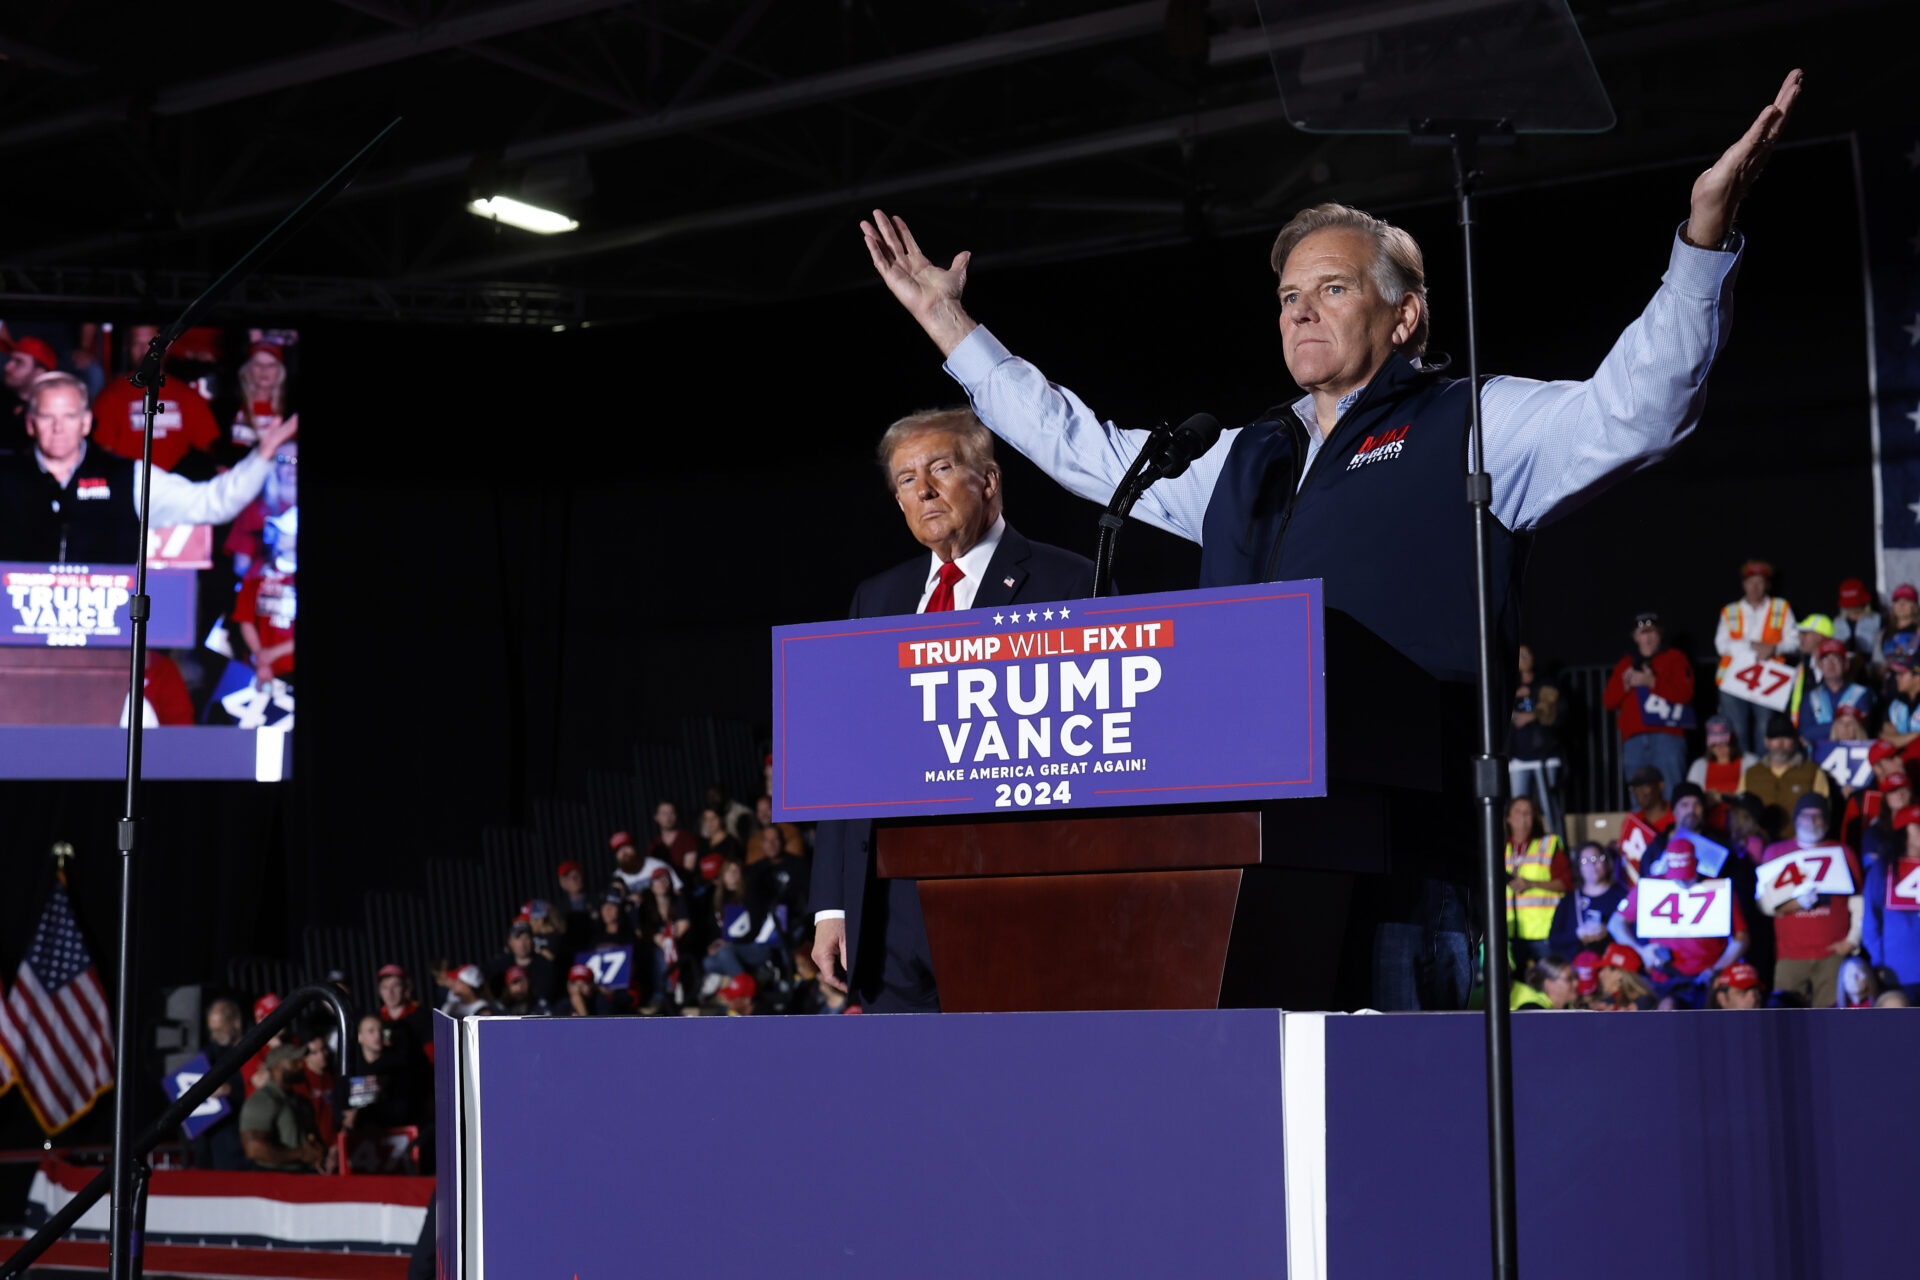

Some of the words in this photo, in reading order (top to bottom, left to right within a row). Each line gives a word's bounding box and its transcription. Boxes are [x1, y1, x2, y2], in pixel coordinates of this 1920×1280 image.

[1349, 439, 1404, 465] ROGERS
[6, 585, 129, 610] TRUMP
[19, 606, 116, 628] VANCE
[909, 637, 1001, 666] TRUMP
[1008, 631, 1074, 658] WILL
[1083, 626, 1128, 652] FIX
[1135, 623, 1162, 648] IT
[910, 655, 1163, 722] TRUMP
[1735, 663, 1791, 696] 47
[937, 711, 1132, 764] VANCE
[925, 769, 965, 783] MAKE
[970, 765, 1035, 780] AMERICA
[1040, 762, 1088, 776] GREAT
[1093, 758, 1147, 774] AGAIN!
[1820, 746, 1873, 788] 47
[995, 780, 1072, 808] 2024
[1774, 856, 1833, 890] 47
[1651, 891, 1716, 925] 47
